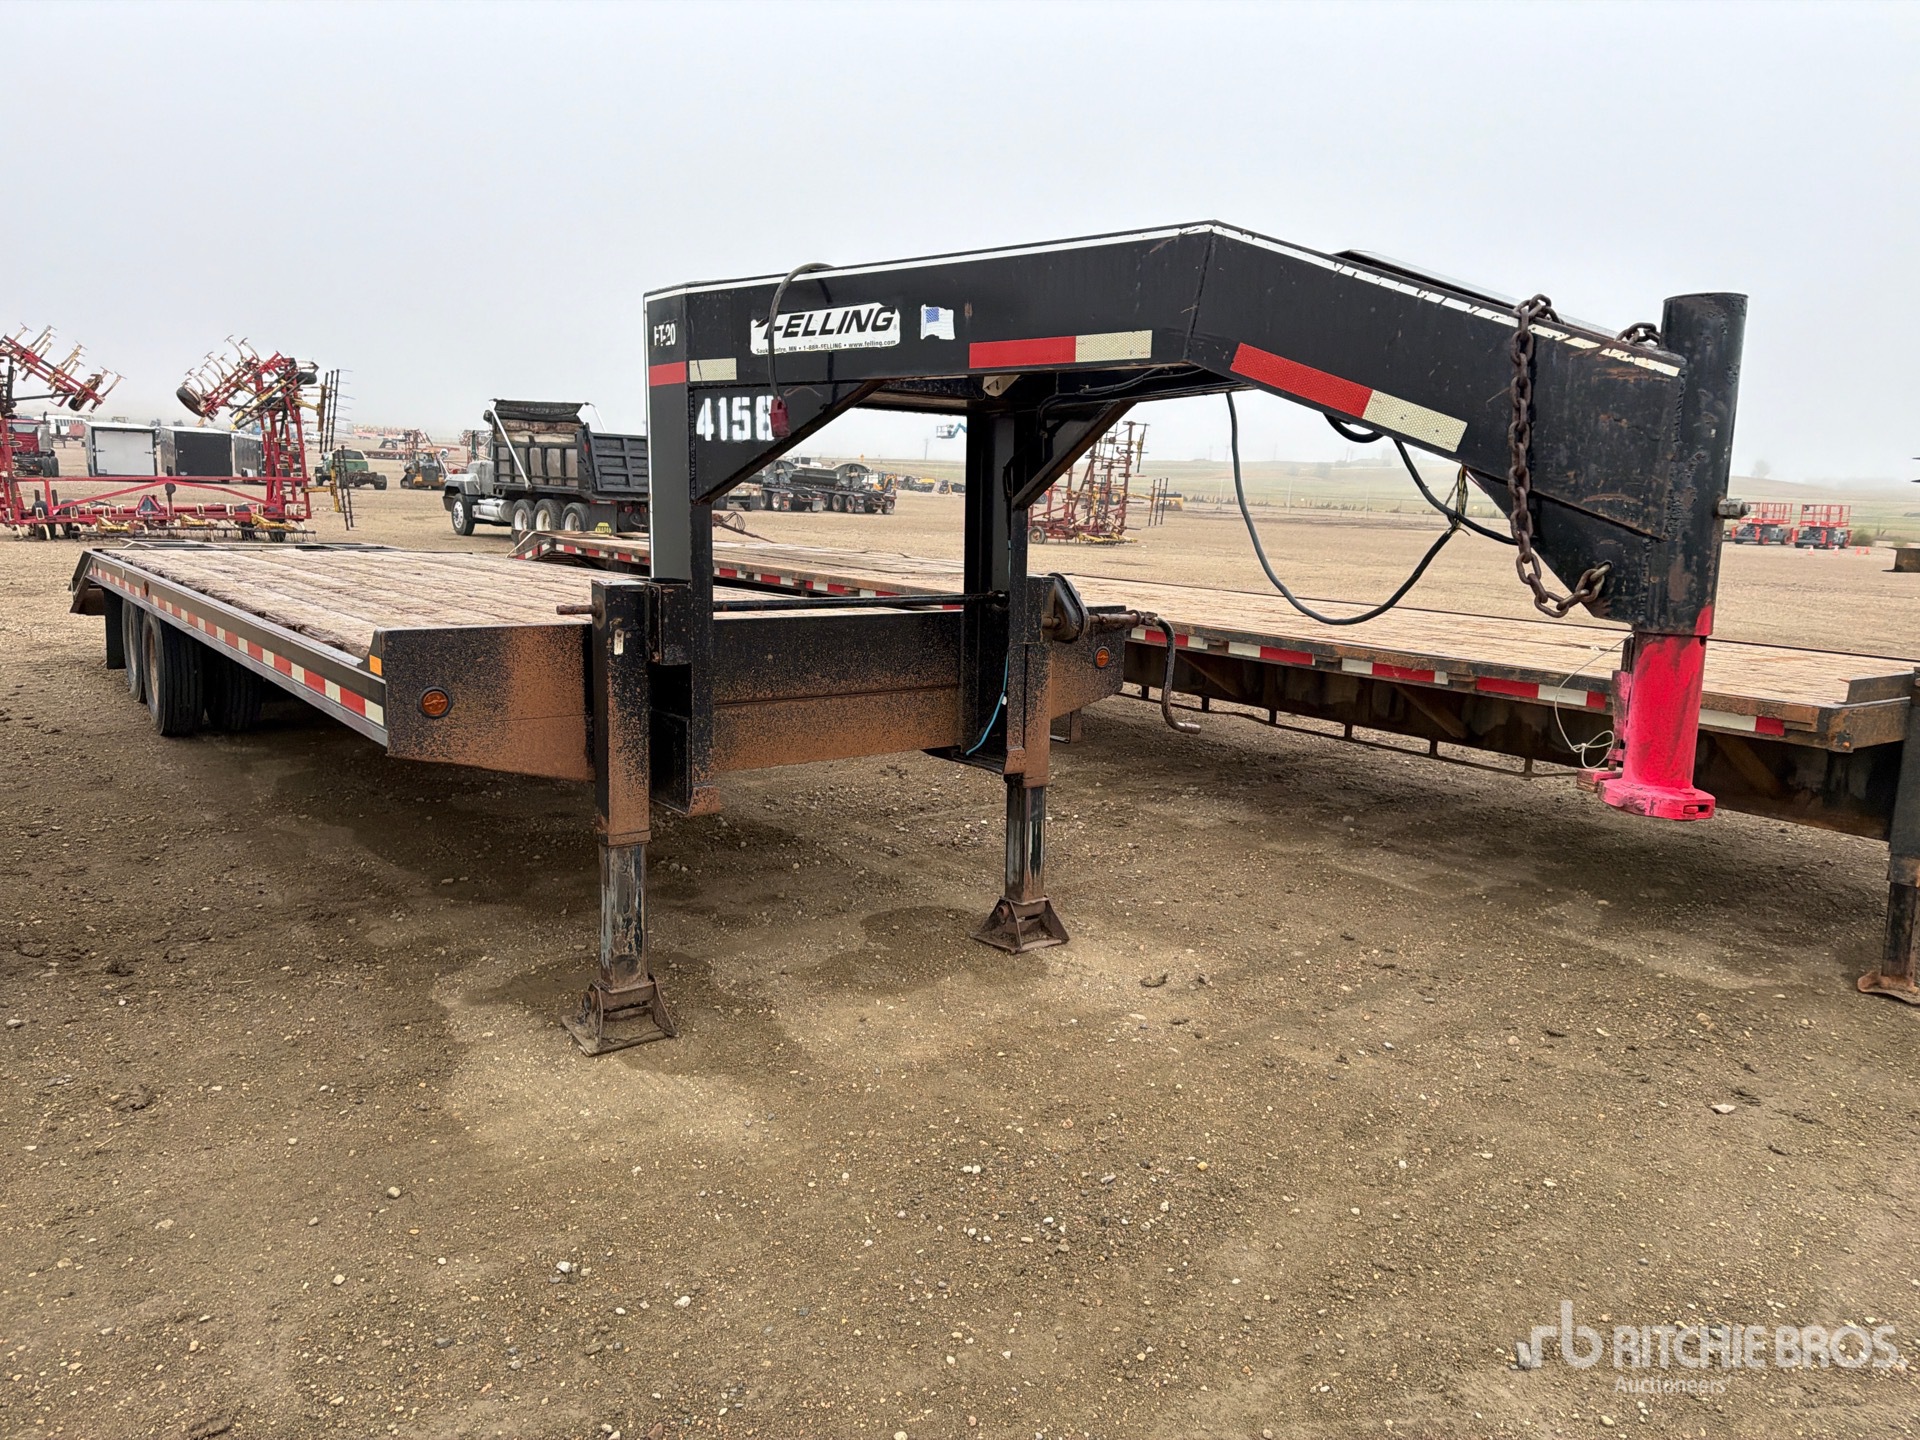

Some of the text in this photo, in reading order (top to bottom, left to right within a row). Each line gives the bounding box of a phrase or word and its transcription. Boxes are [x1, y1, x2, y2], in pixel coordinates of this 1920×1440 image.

[653, 322, 676, 346] FT-20
[754, 305, 897, 340] FELLING
[848, 340, 896, 348] www.felling.com
